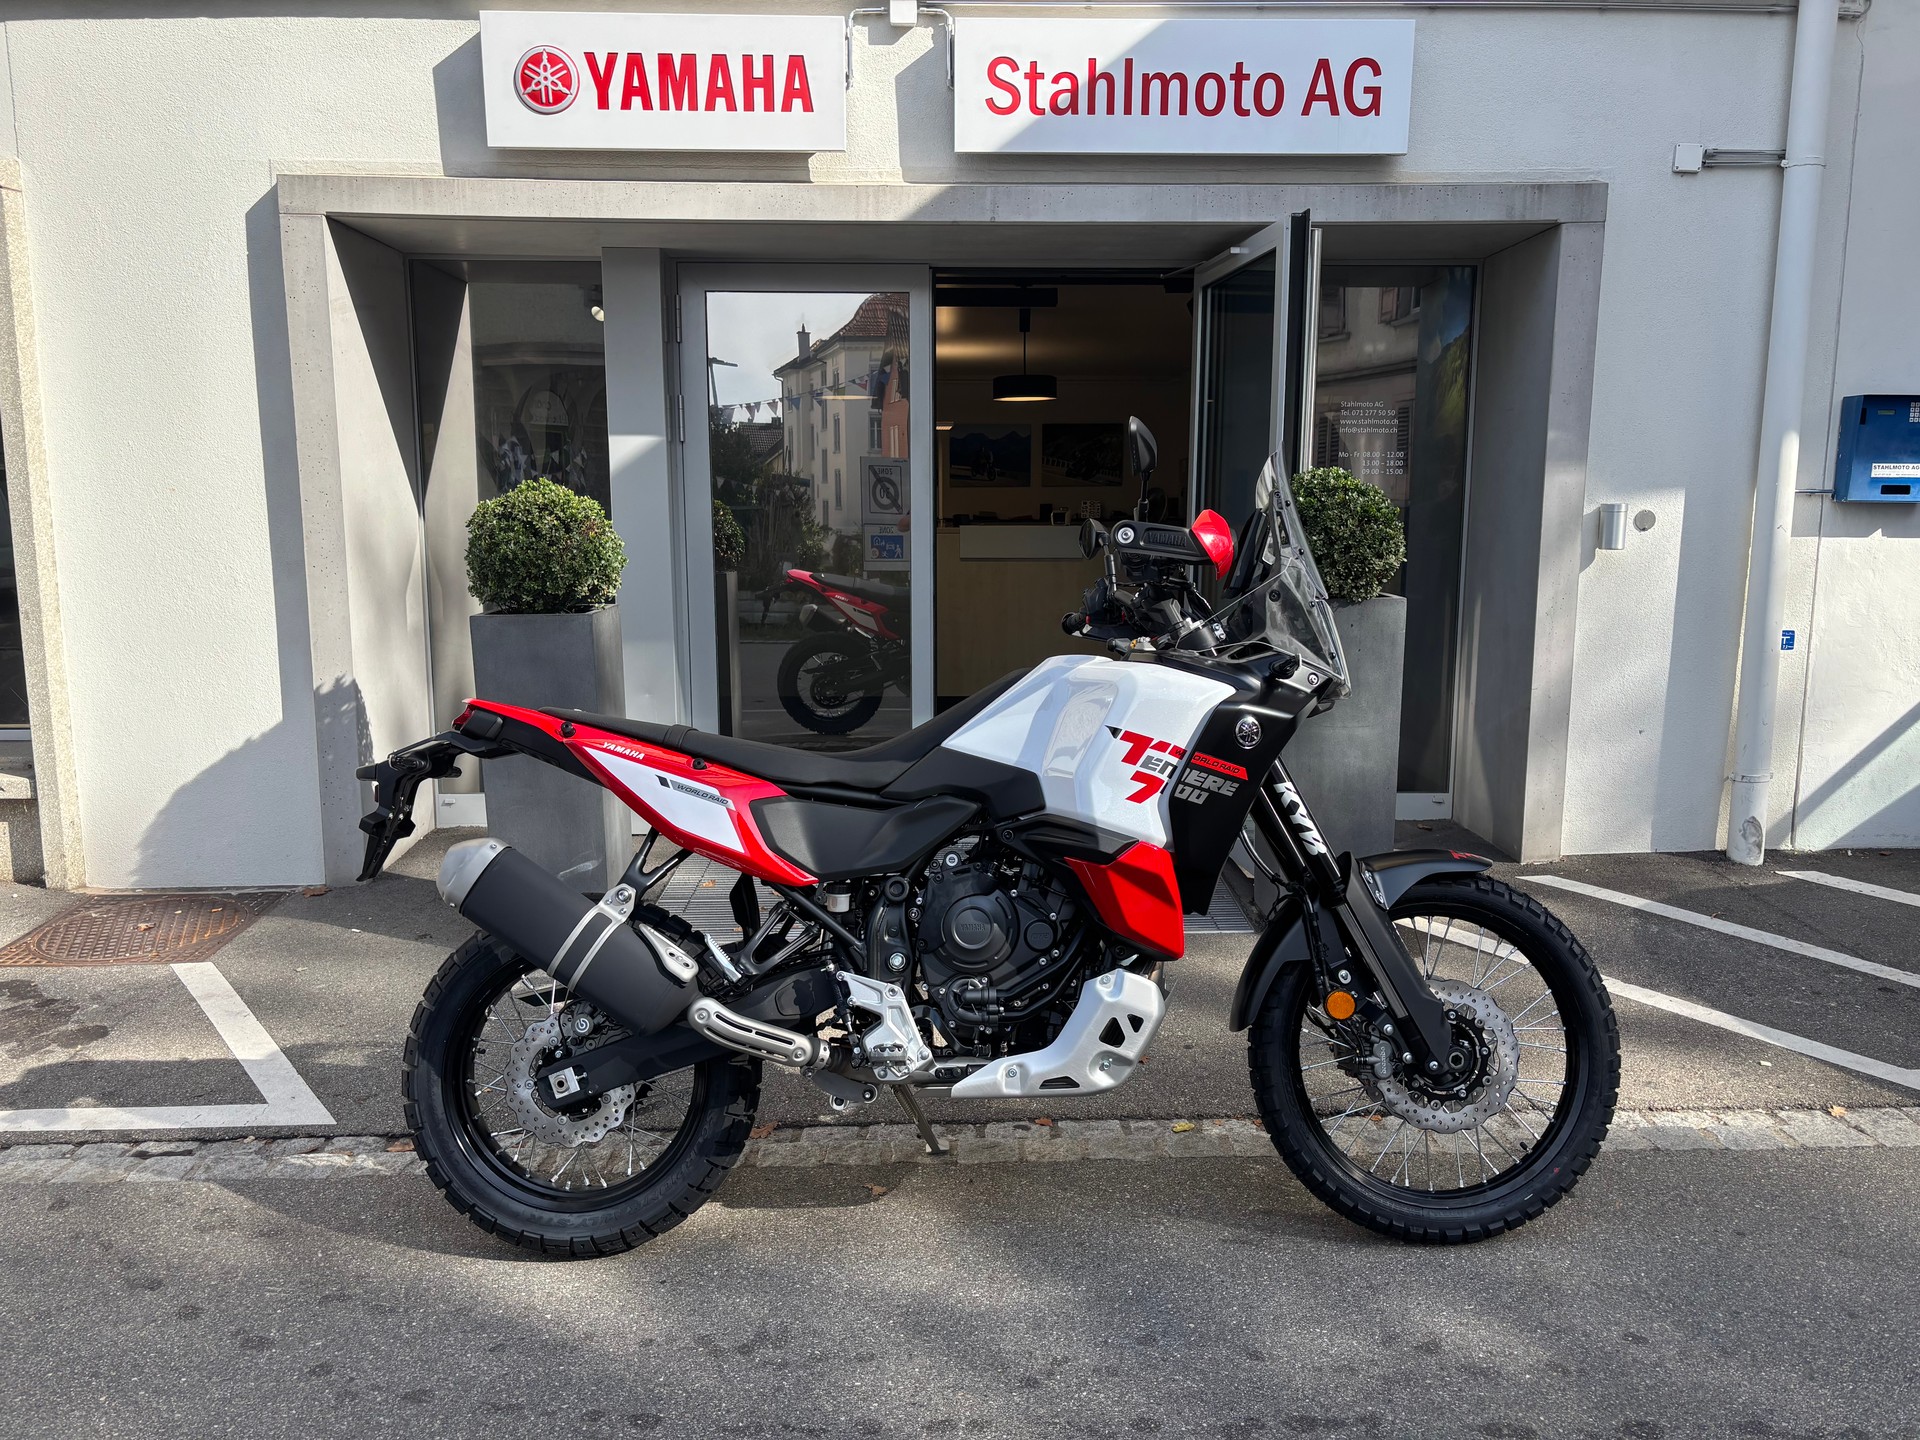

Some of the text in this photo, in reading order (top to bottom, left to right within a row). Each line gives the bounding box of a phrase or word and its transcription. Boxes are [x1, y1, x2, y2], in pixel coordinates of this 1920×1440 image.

[582, 51, 814, 113] YAMAHA
[985, 55, 1384, 118] Stahlmoto AG
[1149, 532, 1187, 547] YAMAHA
[602, 741, 646, 760] YAMAHA
[1219, 763, 1241, 774] RAID
[677, 784, 729, 805] WORLD RAID
